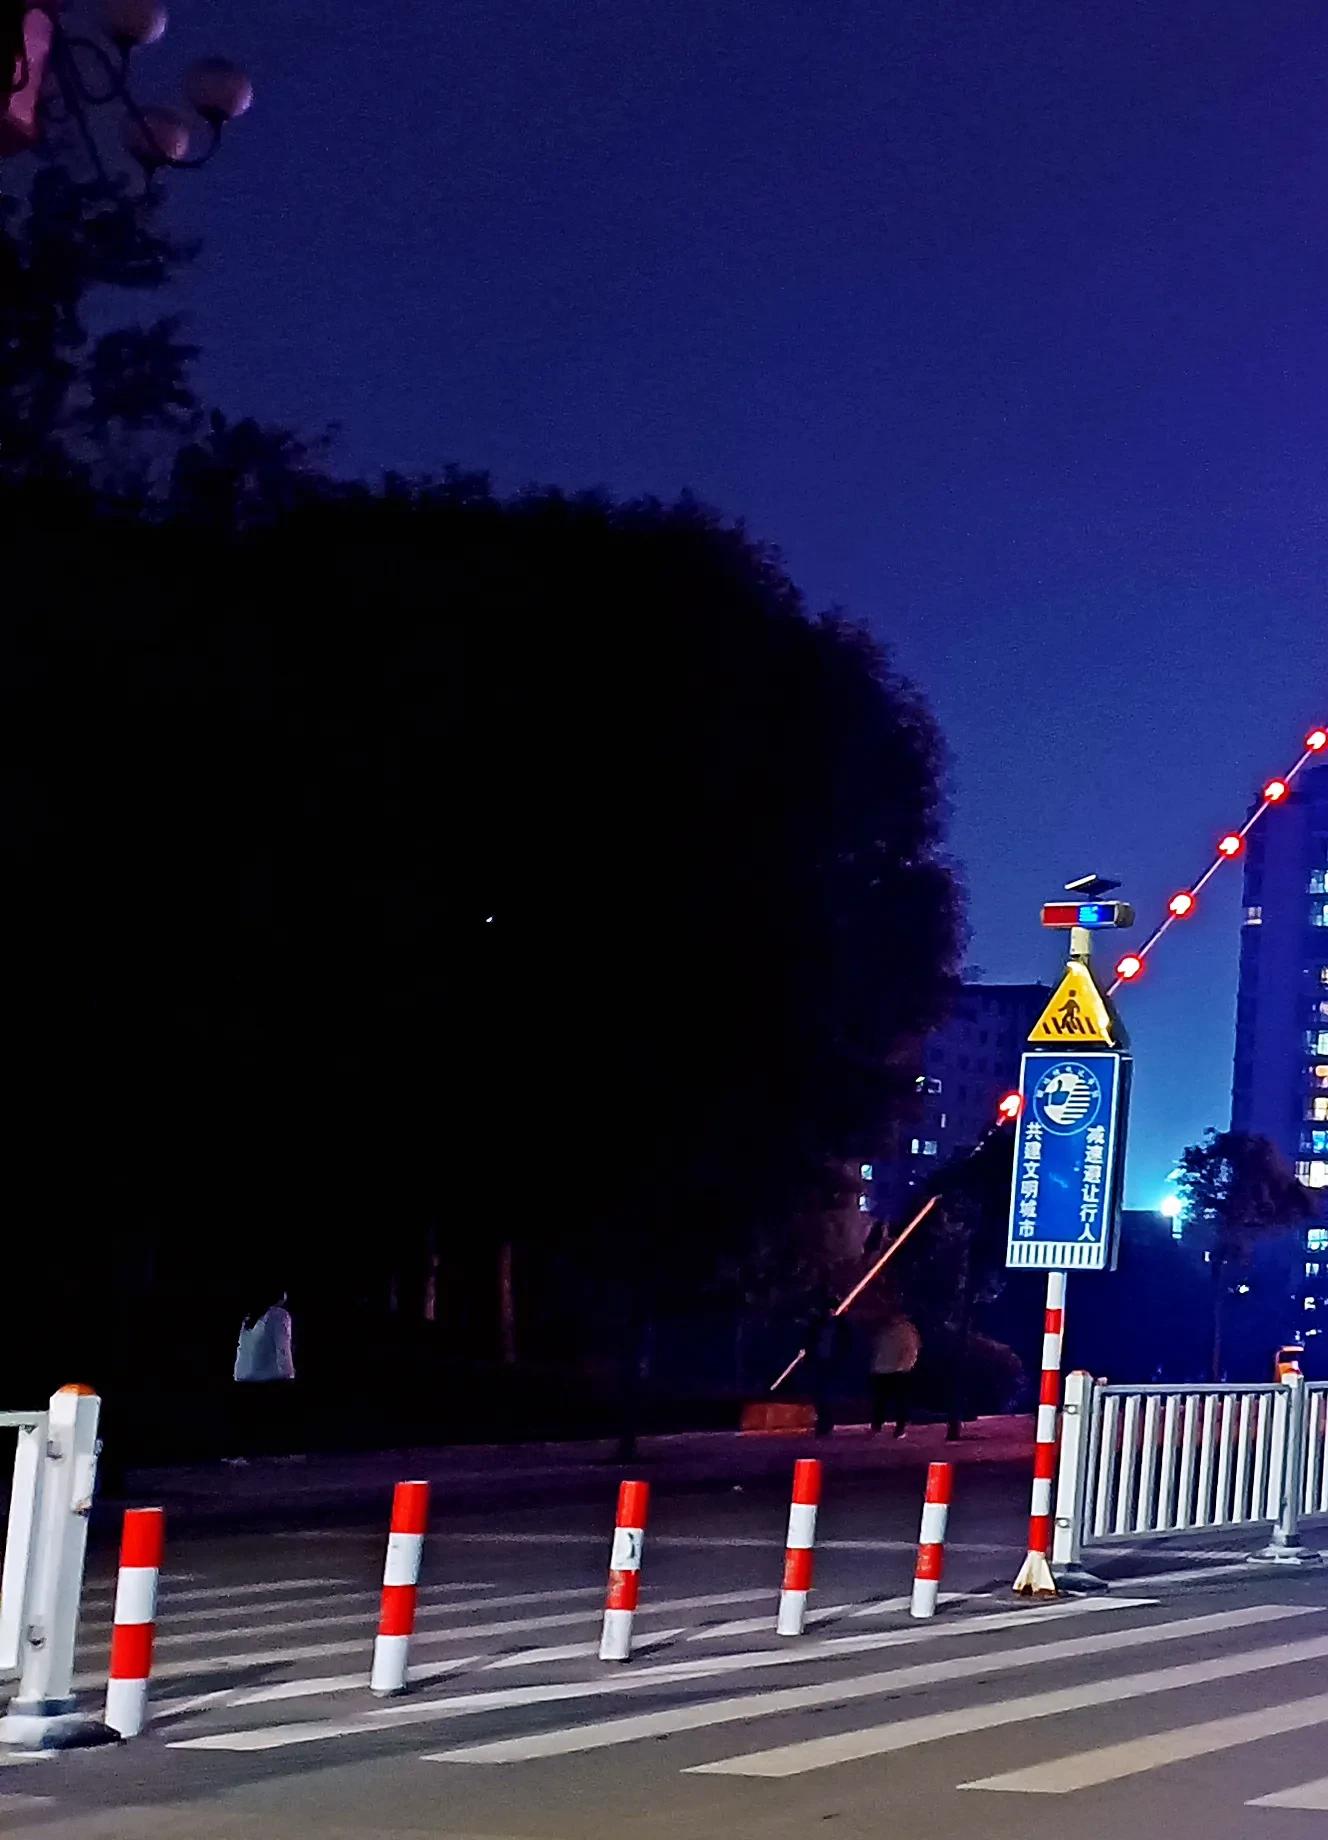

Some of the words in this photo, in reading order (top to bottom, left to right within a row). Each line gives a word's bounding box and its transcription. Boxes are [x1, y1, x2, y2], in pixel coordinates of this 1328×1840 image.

[1019, 1122, 1042, 1237] 共建文明城市
[1078, 1126, 1105, 1241] 减速避让行人
